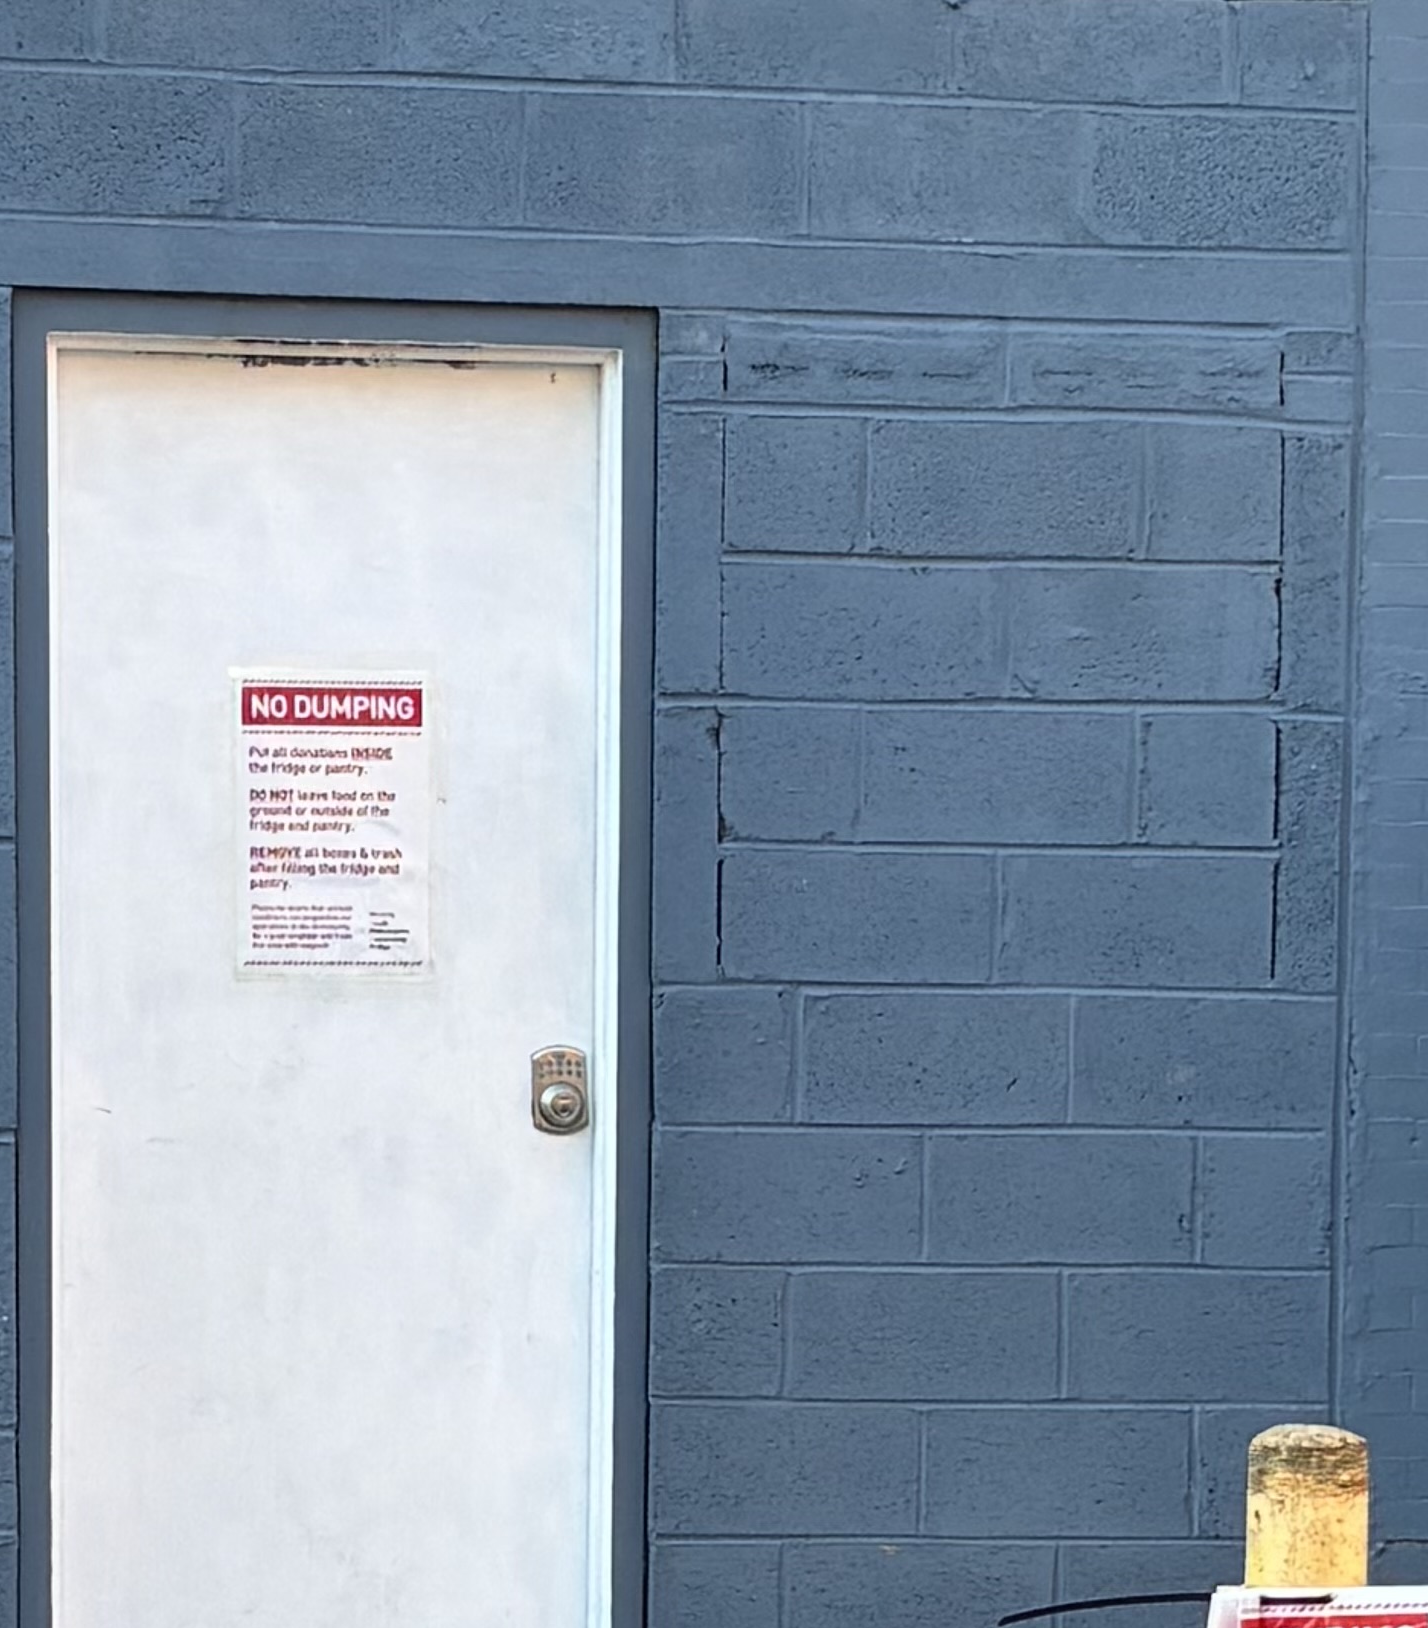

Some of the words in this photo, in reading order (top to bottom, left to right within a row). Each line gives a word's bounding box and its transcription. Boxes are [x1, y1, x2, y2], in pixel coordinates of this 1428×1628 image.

[251, 693, 288, 719] NO
[294, 694, 415, 720] DUMPING
[272, 747, 287, 758] all
[290, 746, 348, 758] donations
[249, 762, 268, 774] the
[271, 762, 306, 776] fridge
[309, 764, 322, 774] or
[325, 763, 369, 777] pantry.
[249, 788, 266, 801] DO
[270, 788, 294, 801] NOT
[297, 789, 328, 801] leave
[332, 789, 357, 801] food
[360, 792, 374, 801] on
[377, 789, 396, 801] the
[249, 805, 292, 818] ground
[295, 807, 307, 816] or
[310, 804, 353, 816] outside
[356, 805, 368, 816] of
[371, 805, 390, 817] the
[249, 819, 285, 833] fridge
[288, 820, 310, 831] and
[249, 846, 301, 859] REMOVE
